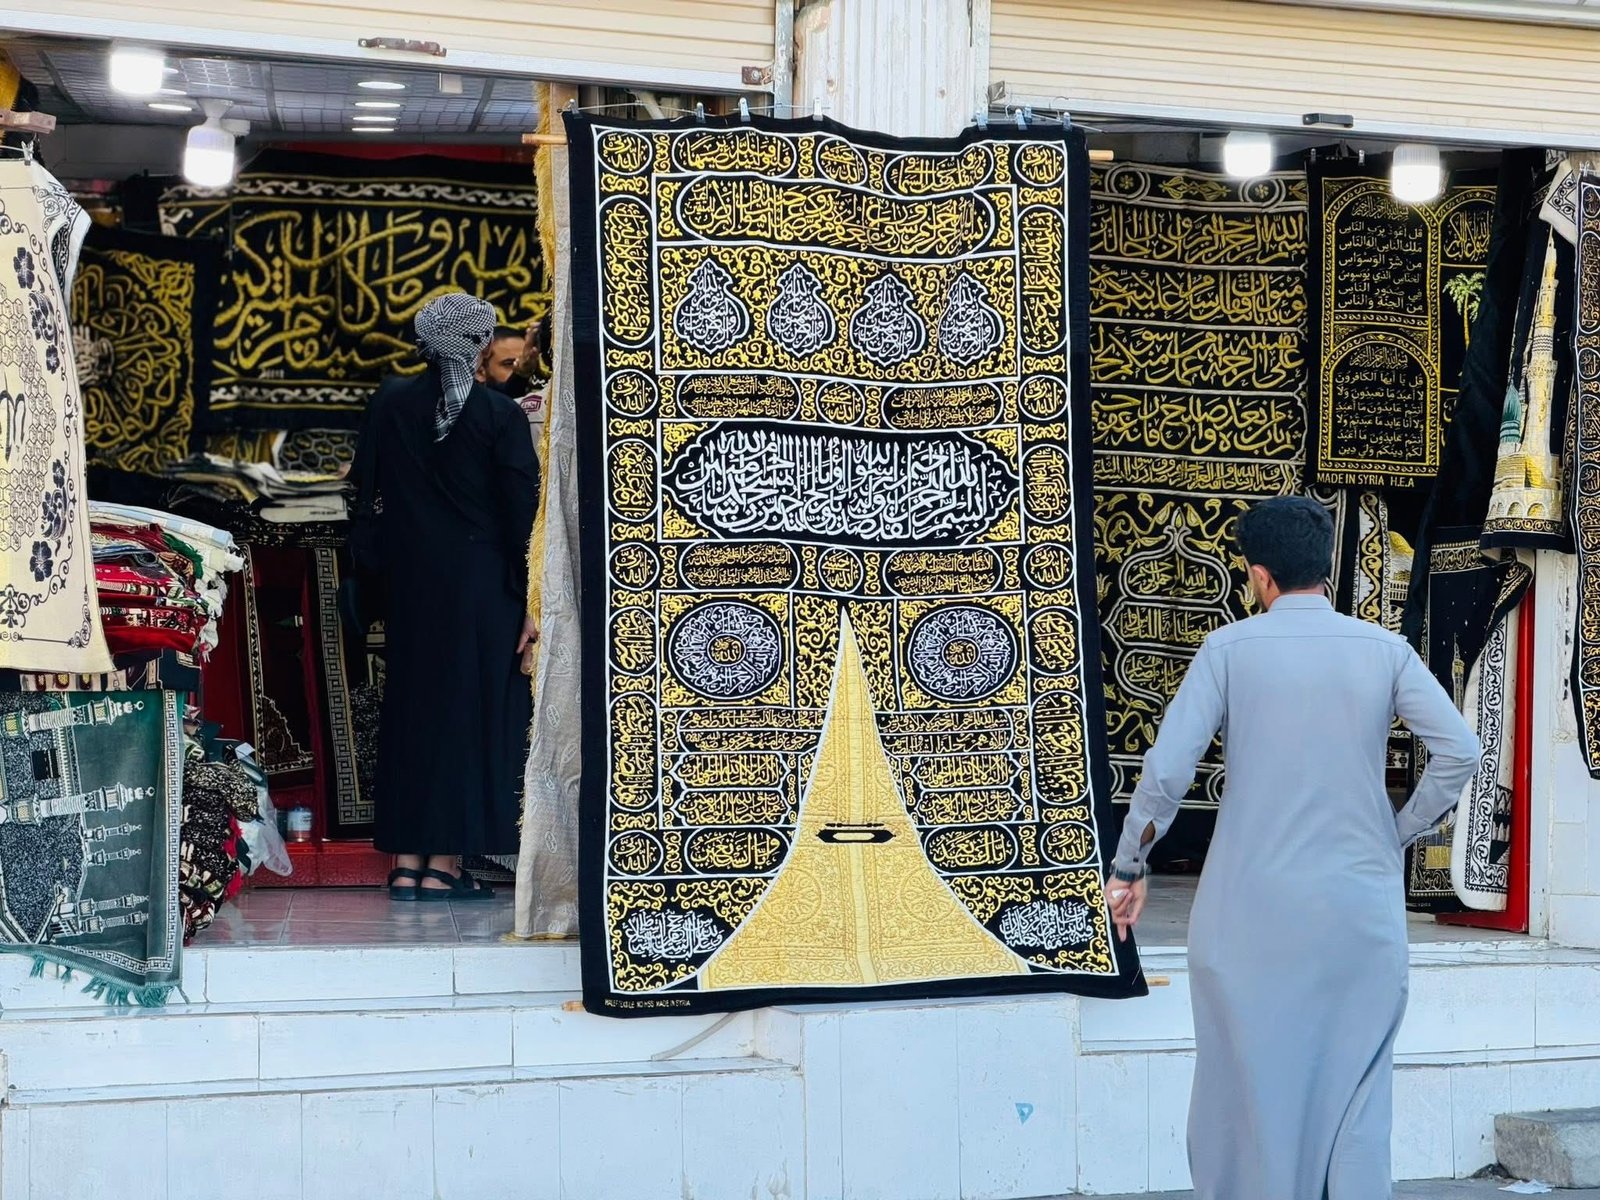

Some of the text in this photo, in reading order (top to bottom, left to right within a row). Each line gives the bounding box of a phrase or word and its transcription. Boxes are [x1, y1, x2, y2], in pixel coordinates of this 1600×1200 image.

[1339, 221, 1364, 234] الناس
[1368, 226, 1385, 237] برب
[1409, 226, 1423, 239] قل
[1339, 236, 1366, 250] الناس
[1377, 239, 1399, 252] الناس
[1400, 240, 1422, 252] ملك
[1339, 252, 1422, 271] من شر الوسواس
[1339, 269, 1370, 281] يوسوس
[1373, 270, 1391, 283] الذي
[1339, 282, 1422, 302] في صدور الناس
[1338, 294, 1423, 313] من الجنة والناس
[1335, 371, 1377, 384] الكافرون
[1400, 373, 1406, 386] يا
[1409, 374, 1424, 388] قل
[1336, 386, 1349, 399] ولا
[1387, 388, 1395, 399] ما
[1417, 390, 1424, 400] لا
[1358, 402, 1366, 411] ما
[1367, 402, 1402, 414] عابدون
[1336, 414, 1349, 427] ولا
[1349, 414, 1373, 428] عبدتم
[1375, 416, 1383, 426] ما
[1384, 417, 1401, 429] عابد
[1359, 430, 1367, 440] ما
[1370, 432, 1402, 444] عابدون
[1338, 444, 1423, 460] لكم دينكم ولي دين
[1317, 473, 1415, 487] MADE IN SYRIA H.E.A
